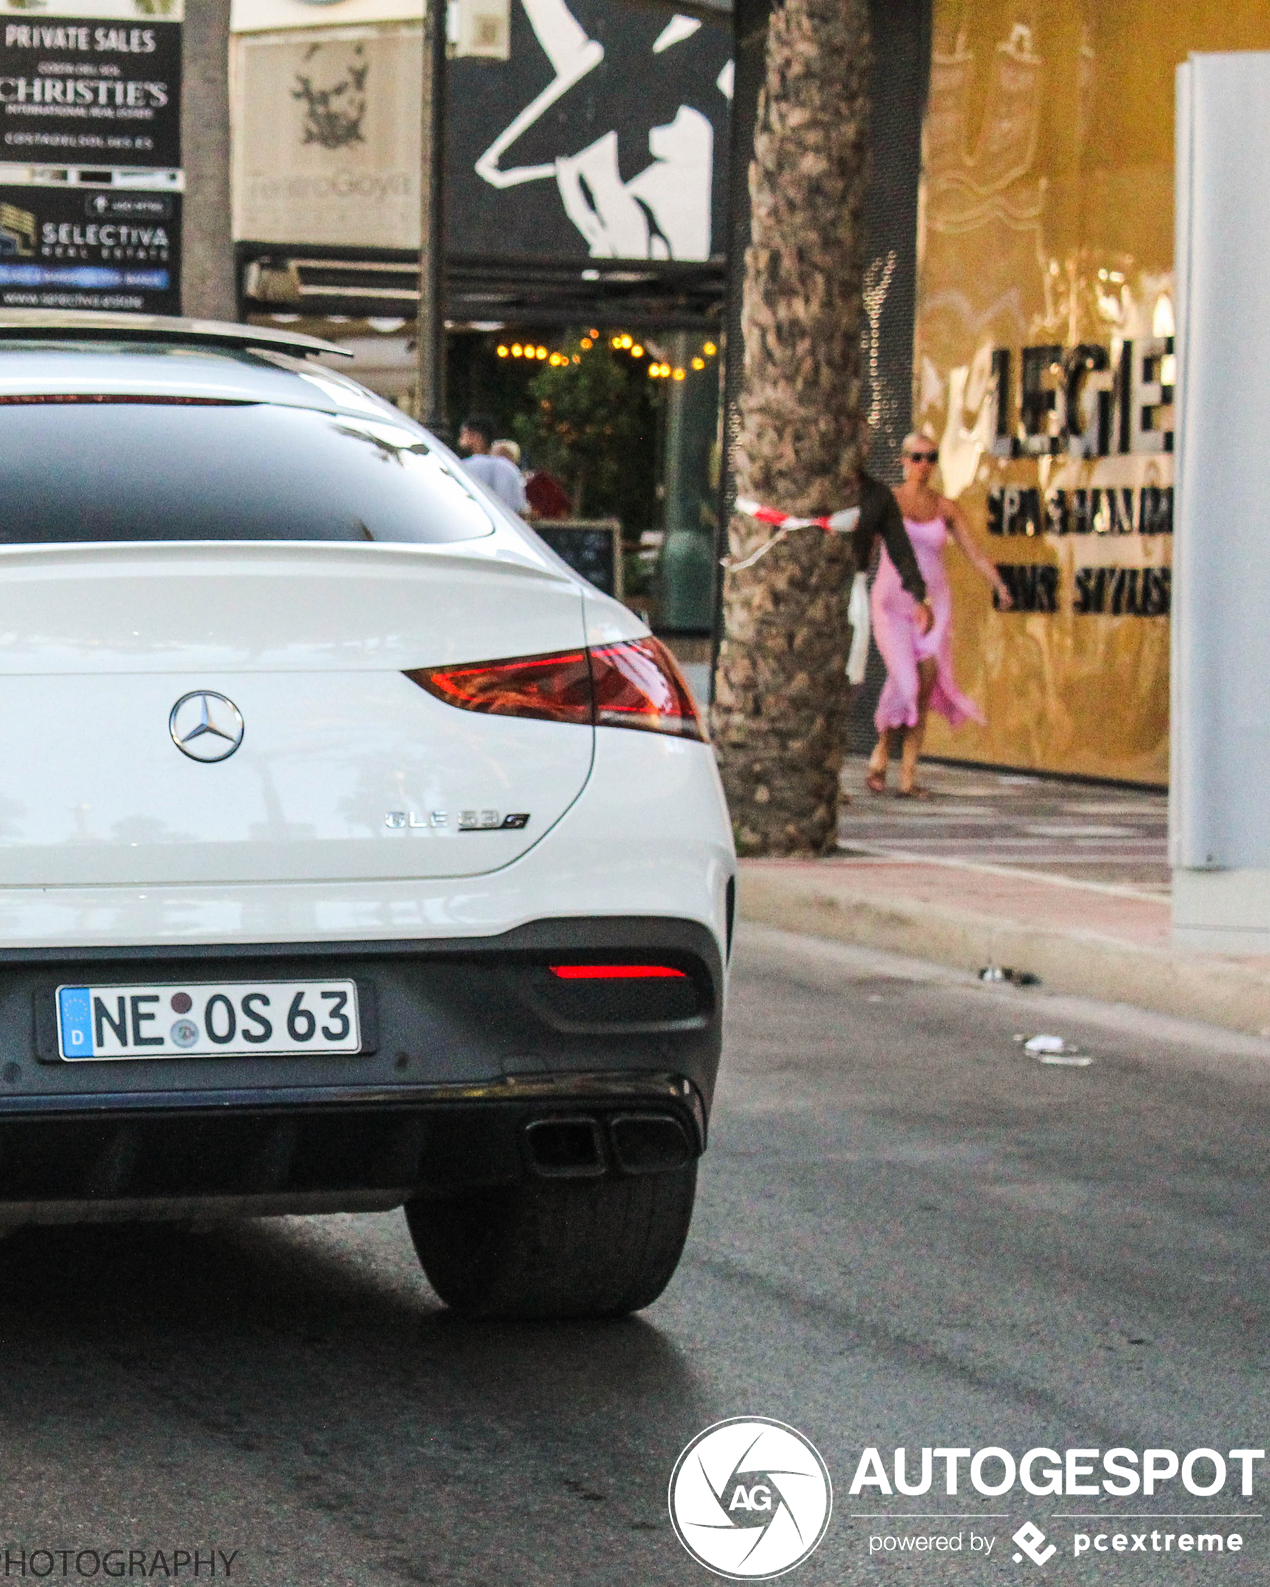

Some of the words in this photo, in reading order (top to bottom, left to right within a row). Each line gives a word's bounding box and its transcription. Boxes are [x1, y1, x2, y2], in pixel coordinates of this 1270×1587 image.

[5, 24, 89, 50] PRIVATE
[94, 27, 157, 53] SALES
[42, 222, 170, 248] SELECTIVA
[385, 810, 448, 828] GLE
[71, 1029, 85, 1046] D
[93, 994, 165, 1048] NE
[204, 992, 273, 1045] OS
[286, 990, 350, 1043] 63
